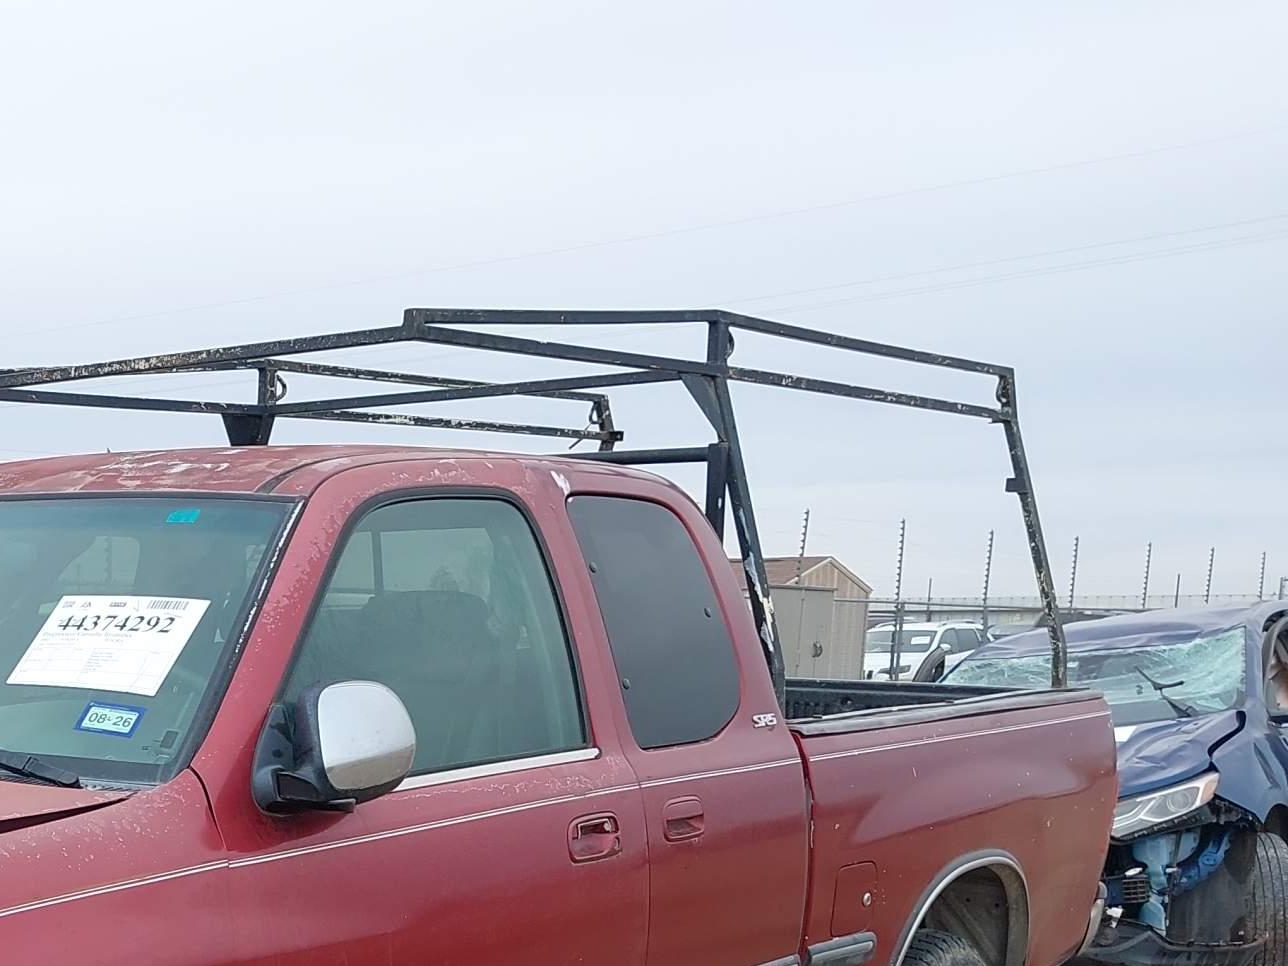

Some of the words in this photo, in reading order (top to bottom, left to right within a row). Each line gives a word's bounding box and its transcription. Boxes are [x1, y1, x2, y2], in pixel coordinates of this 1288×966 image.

[58, 615, 176, 633] 44374292
[112, 716, 133, 728] 26
[752, 713, 777, 728] SR5
